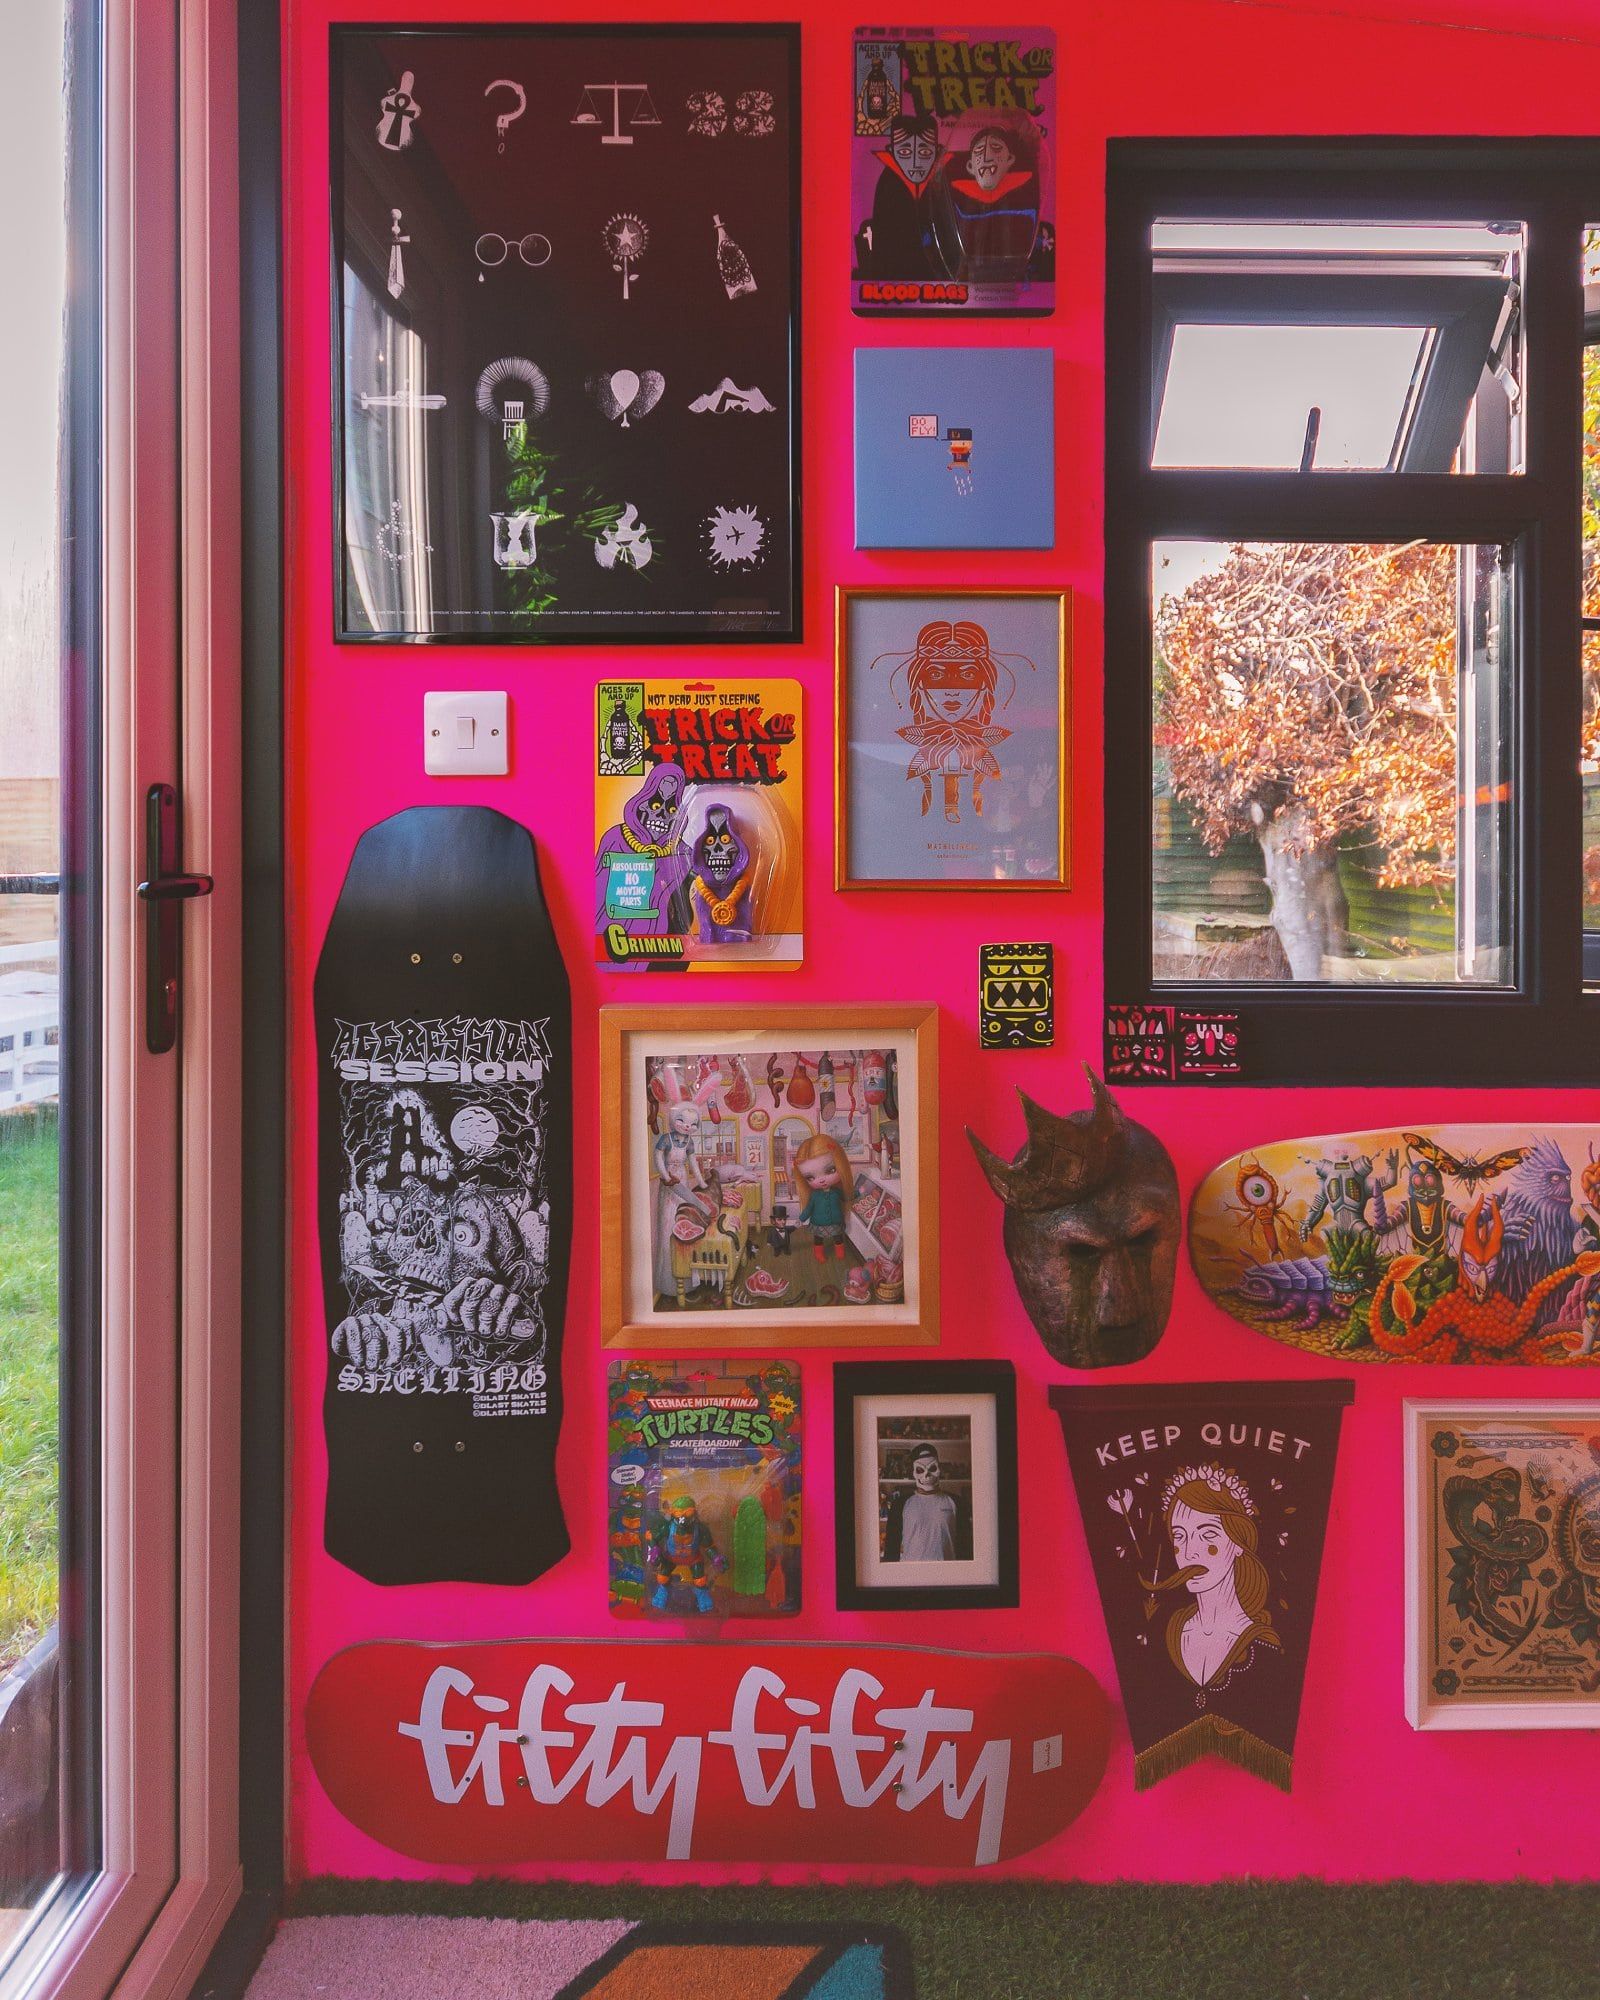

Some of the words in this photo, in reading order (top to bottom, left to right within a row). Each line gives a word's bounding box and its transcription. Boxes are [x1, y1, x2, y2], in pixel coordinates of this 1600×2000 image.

[905, 41, 1028, 73] TRICK
[1029, 48, 1053, 67] OR
[912, 77, 1039, 110] TREAT
[862, 284, 920, 301] BLOOD
[922, 284, 968, 302] BAGS
[912, 417, 926, 426] DO
[912, 426, 935, 435] FLY!
[601, 686, 622, 694] AGES
[626, 686, 639, 694] 666
[648, 695, 666, 706] NOT
[669, 695, 691, 705] DEAD
[694, 695, 717, 705] JUST
[719, 694, 760, 705] SLEEPING
[645, 707, 770, 741] TRICK
[770, 713, 796, 734] OR
[652, 744, 784, 779] TREAT
[611, 862, 653, 871] ABSOLUTELY
[625, 873, 639, 885] NO
[616, 886, 646, 896] MOVING
[620, 897, 641, 906] PARTS
[331, 1015, 552, 1072] AGGRESSION
[339, 1060, 543, 1082] SESSION
[749, 1152, 761, 1163] 21
[511, 1392, 547, 1400] SKATES
[511, 1399, 547, 1408] SKATES
[648, 1398, 694, 1409] TEENAGE
[694, 1398, 729, 1408] MUTANT
[730, 1398, 759, 1408] NINJA
[511, 1407, 547, 1415] SKATES
[632, 1407, 774, 1448] TURTLES
[669, 1439, 742, 1448] SKATEBOARDIN'
[1095, 1425, 1182, 1466] KEEP
[1200, 1422, 1311, 1460] QUIET
[692, 1447, 717, 1455] MIKE
[398, 1663, 702, 1860] fifty
[708, 1665, 1011, 1866] fifty
